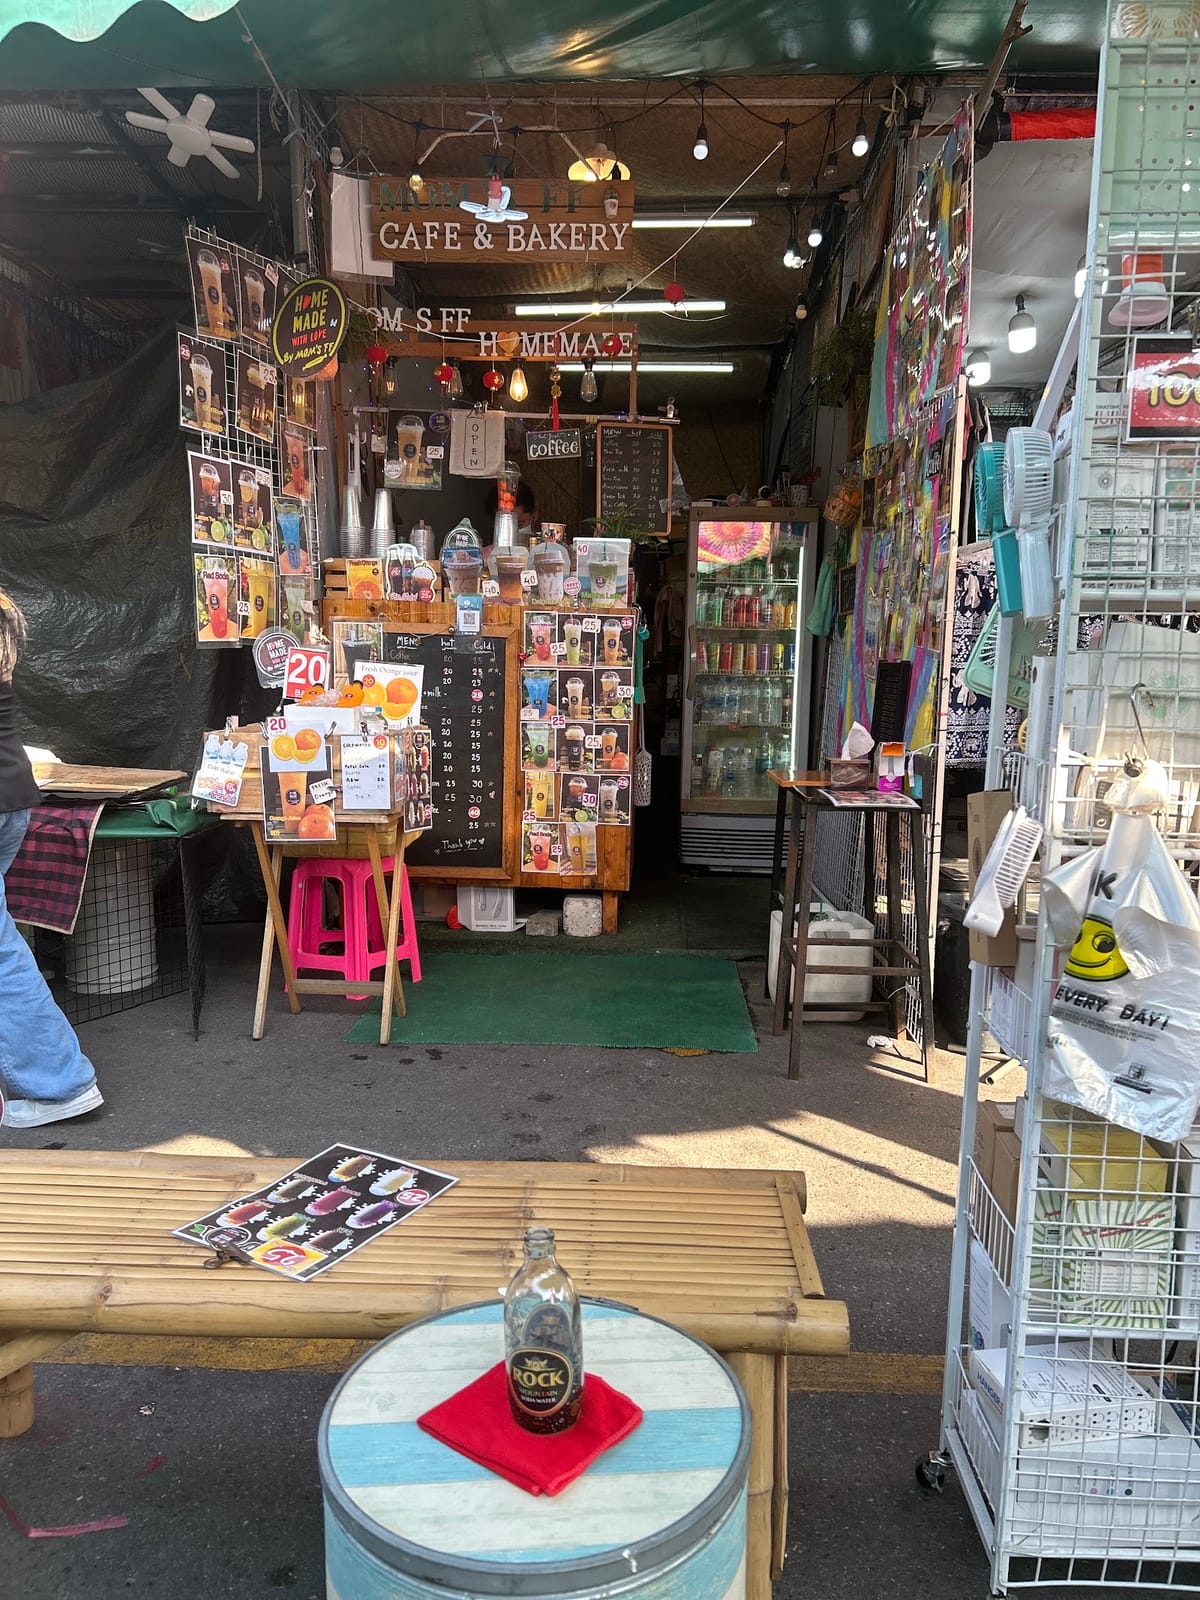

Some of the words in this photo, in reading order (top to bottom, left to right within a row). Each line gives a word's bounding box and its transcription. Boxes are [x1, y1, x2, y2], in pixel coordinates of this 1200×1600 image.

[379, 222, 462, 251] CAFE
[472, 224, 494, 250] &
[507, 223, 629, 252] BAKERY
[292, 309, 327, 333] MADE
[416, 308, 432, 332] S
[440, 308, 471, 333] FF
[292, 334, 308, 346] WITH
[311, 329, 327, 342] LOVE
[324, 342, 335, 354] FF
[470, 423, 480, 467] OPEN
[530, 438, 579, 458] coffee
[203, 571, 214, 580] Red
[440, 637, 456, 648] hot
[269, 647, 288, 660] MADE
[288, 654, 326, 687] 20
[361, 664, 378, 676] Fresh
[443, 667, 453, 675] 20
[472, 667, 483, 676] 25
[364, 677, 374, 686] 20
[442, 678, 452, 687] 20
[471, 680, 482, 688] 25
[471, 705, 483, 714] 25
[269, 718, 287, 731] 20
[441, 718, 452, 726] 20
[470, 719, 482, 727] 25
[552, 715, 565, 726] 25
[441, 729, 451, 737] 20
[470, 730, 481, 739] 25
[443, 741, 453, 749] 20
[472, 742, 481, 751] 25
[442, 752, 453, 760] 20
[471, 753, 481, 762] 25
[443, 765, 453, 773] 20
[471, 765, 481, 774] 25
[446, 779, 456, 788] 25
[472, 780, 483, 789] 30
[445, 794, 456, 803] 25
[468, 795, 482, 804] 30
[582, 796, 596, 804] 30
[523, 812, 536, 821] 25
[469, 821, 479, 829] 25
[442, 839, 464, 850] Thank
[552, 846, 562, 854] 25
[1094, 870, 1118, 900] K
[1055, 985, 1109, 1013] EVERY
[1120, 1004, 1171, 1031] DAY!
[513, 1366, 565, 1388] ROCK
[519, 1387, 558, 1397] MOUNTAIN
